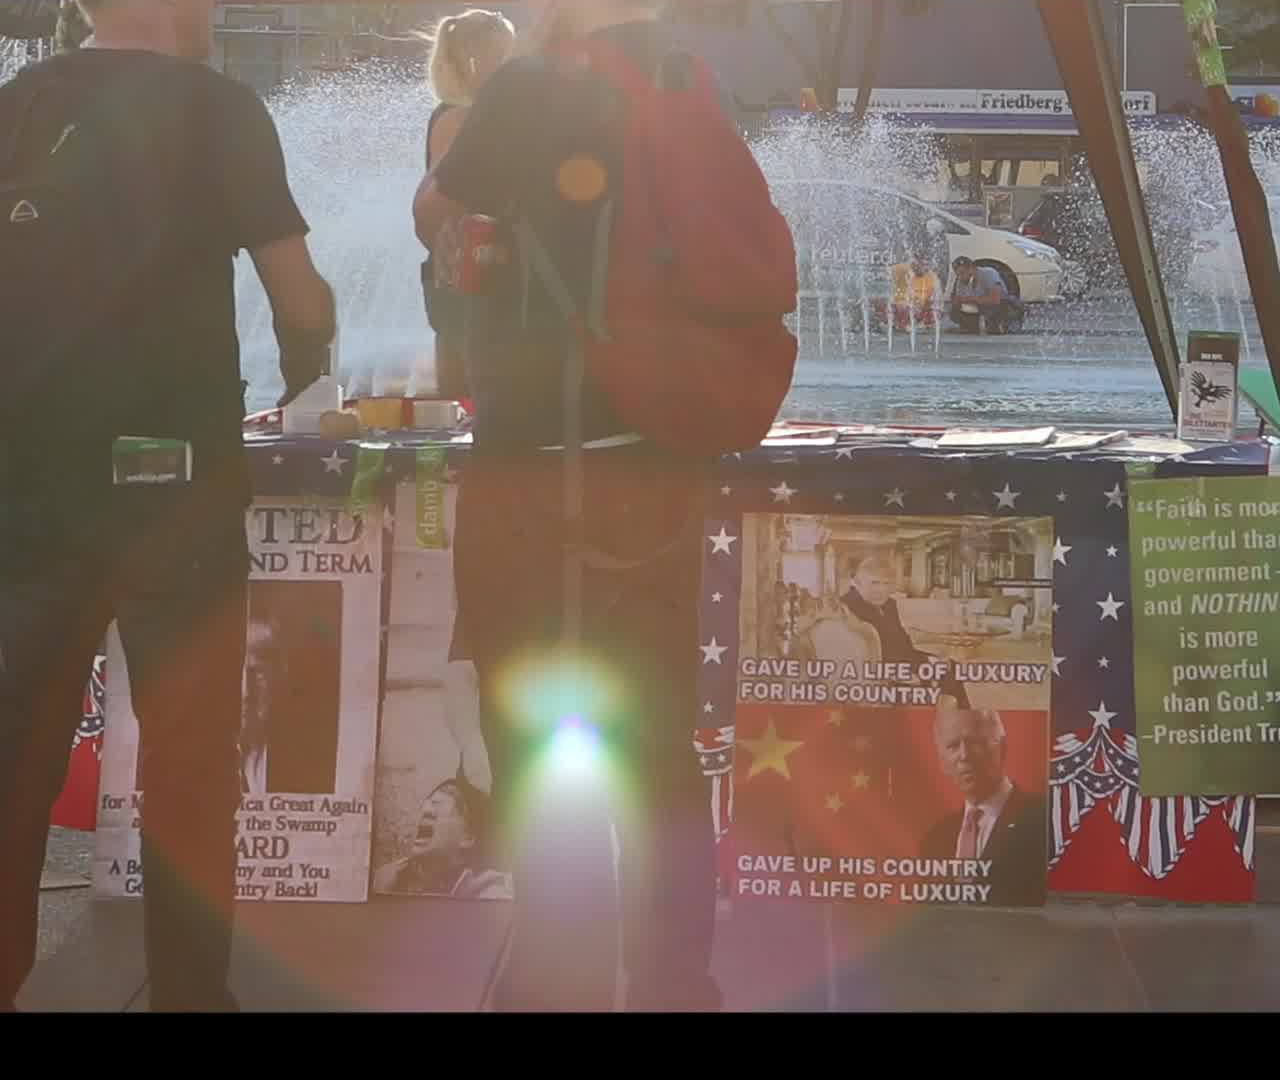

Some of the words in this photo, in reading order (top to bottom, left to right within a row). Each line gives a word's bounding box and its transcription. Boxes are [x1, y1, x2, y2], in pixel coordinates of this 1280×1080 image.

[980, 93, 1063, 113] Friedberg
[1213, 499, 1232, 518] is
[254, 505, 364, 545] TED
[1141, 531, 1238, 557] powerful
[1144, 562, 1271, 587] government
[1143, 594, 1183, 616] and
[1179, 627, 1198, 649] is
[1205, 629, 1259, 649] more
[741, 658, 800, 678] GAVE
[806, 660, 836, 678] UP
[842, 661, 858, 679] A
[863, 662, 912, 681] LIFE
[918, 663, 948, 681] OF
[954, 663, 1046, 683] LUXURY
[1172, 659, 1269, 686] powerful
[740, 682, 785, 700] FOR
[790, 684, 828, 701] HIS
[834, 684, 942, 705] COUNTRY
[1163, 692, 1210, 713] than
[101, 793, 126, 810] for
[269, 795, 314, 813] Great
[319, 797, 368, 817] Again
[245, 815, 271, 831] the
[275, 816, 337, 836] Swamp
[237, 837, 290, 860] ARD
[109, 861, 121, 875] A
[261, 864, 293, 879] and
[298, 863, 330, 879] You
[737, 855, 795, 873] GAVE
[803, 856, 832, 873] UP
[839, 858, 876, 875] HIS
[883, 858, 993, 878] COUNTRY
[275, 882, 318, 898] Back!
[738, 879, 781, 896] FOR
[788, 880, 802, 897] A
[810, 881, 857, 898] LIFE
[863, 881, 893, 899] OF
[900, 882, 992, 902] LUXURY
